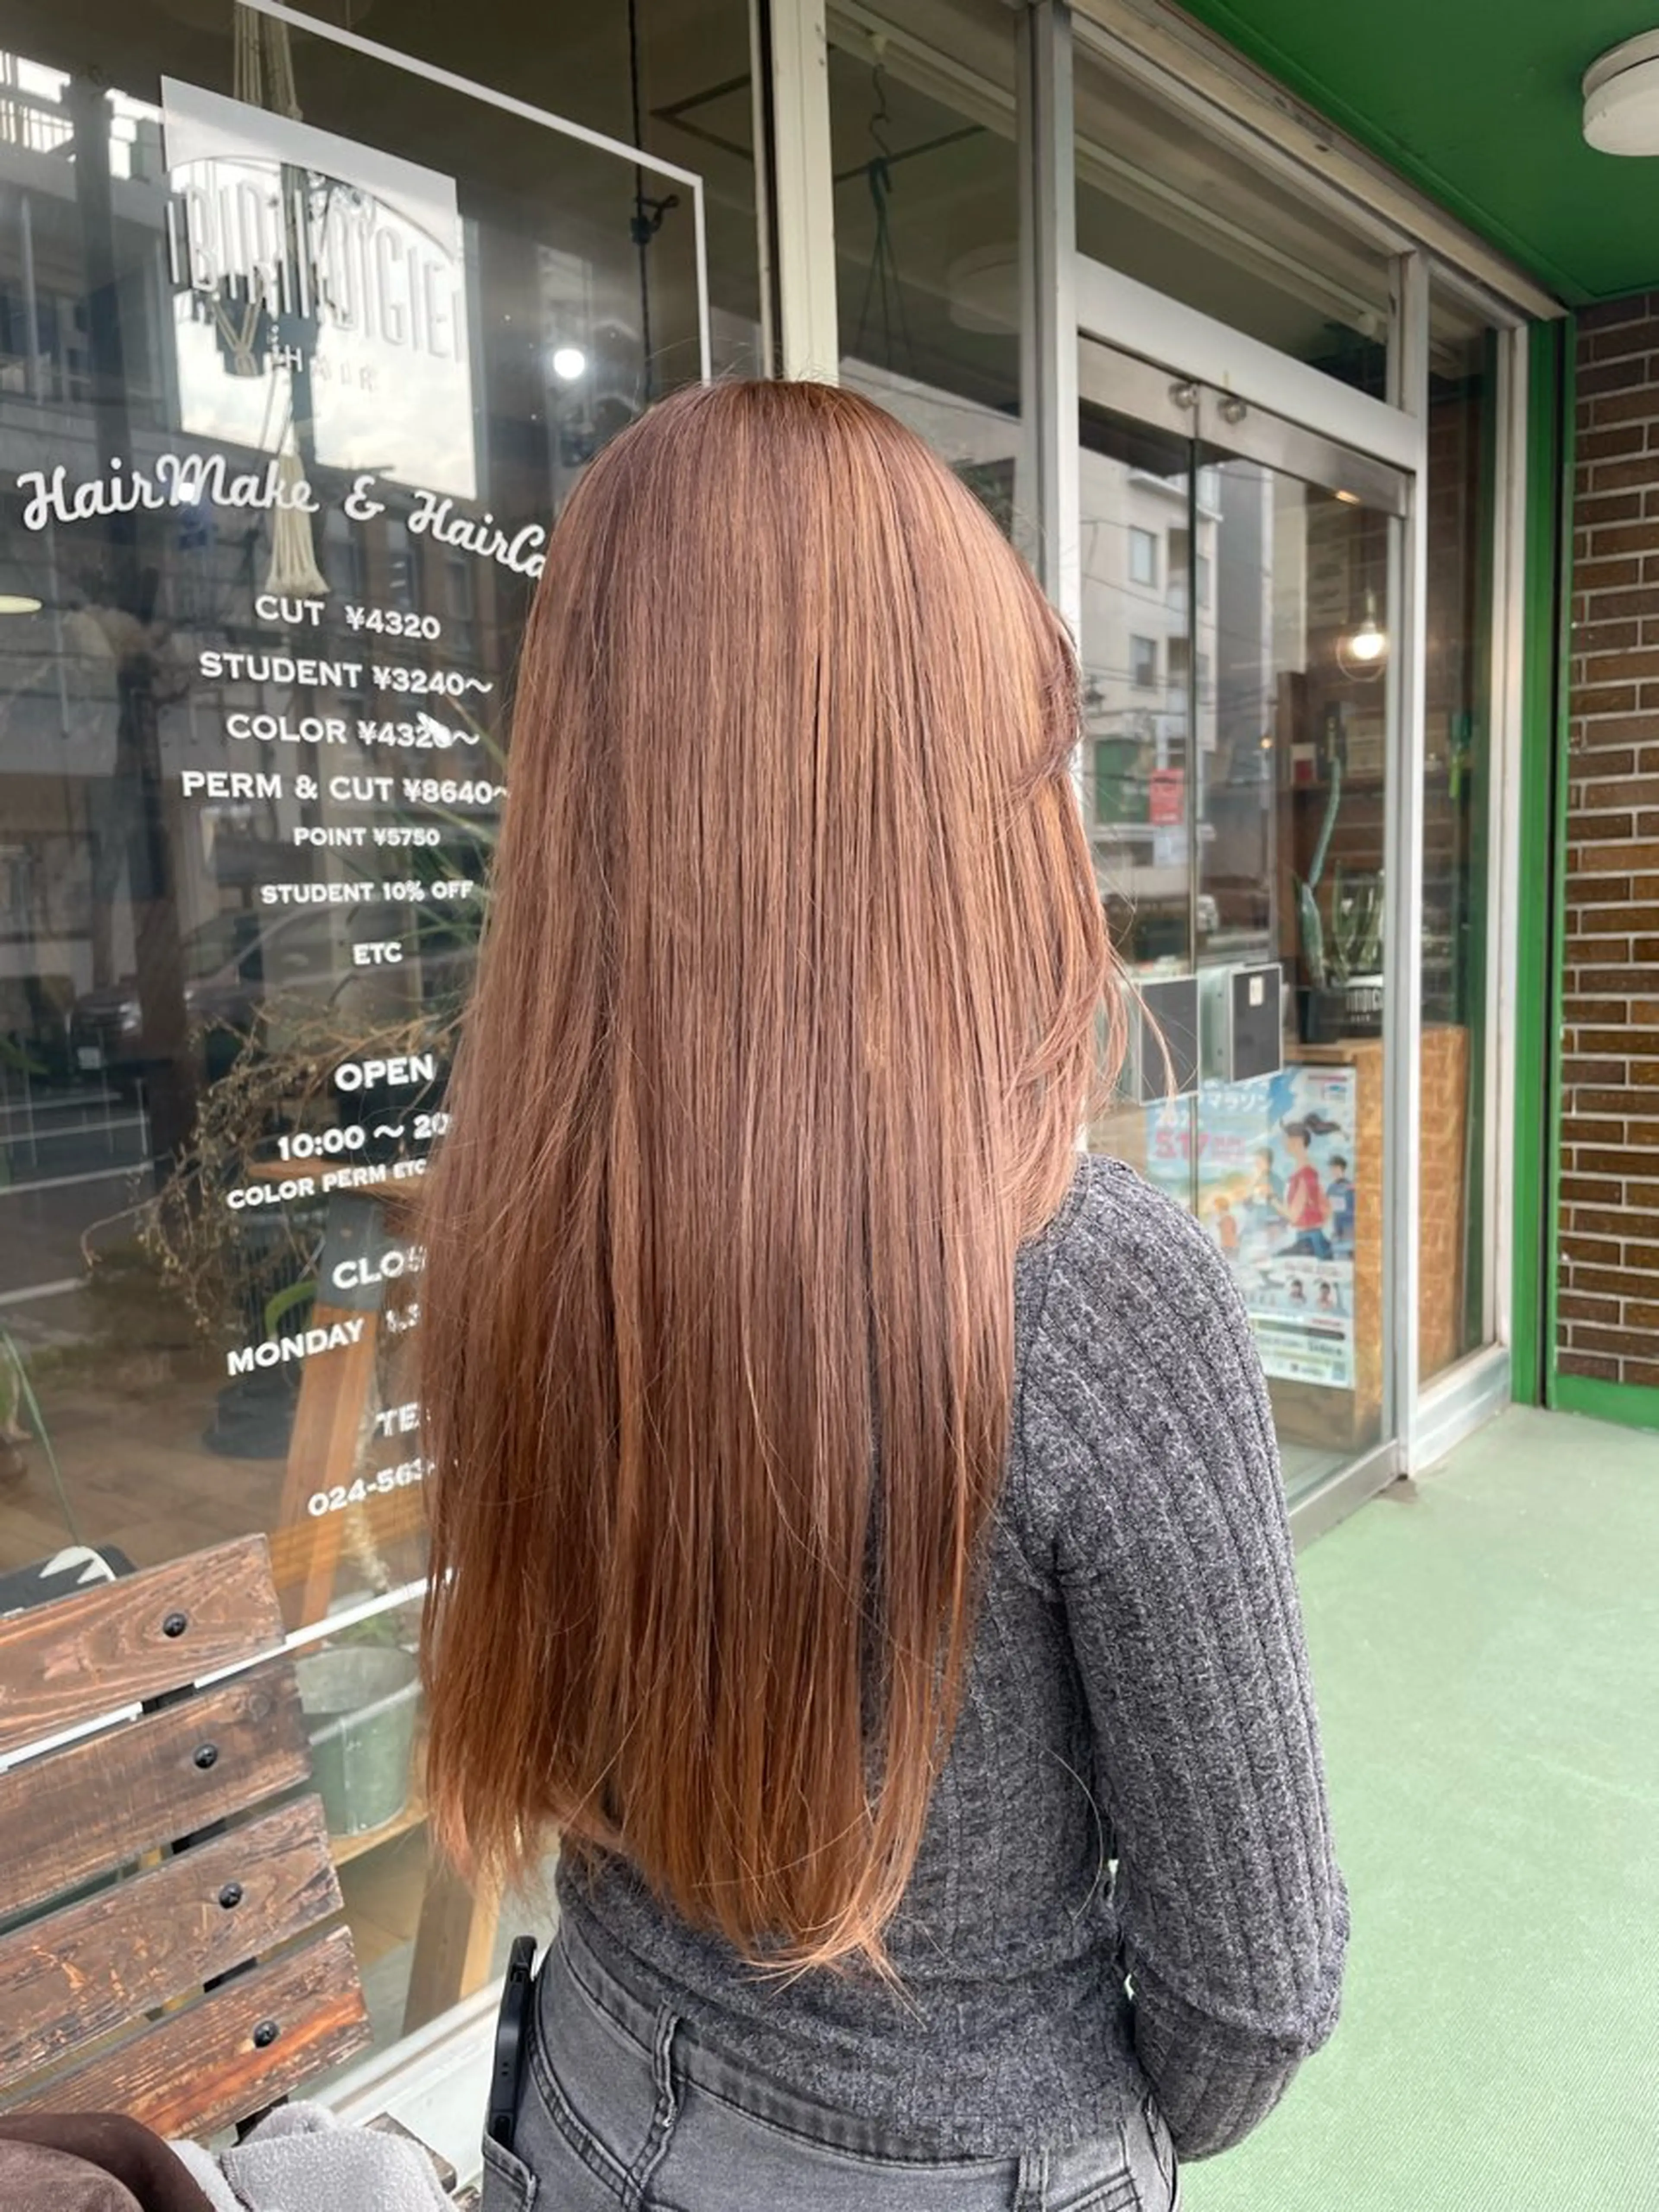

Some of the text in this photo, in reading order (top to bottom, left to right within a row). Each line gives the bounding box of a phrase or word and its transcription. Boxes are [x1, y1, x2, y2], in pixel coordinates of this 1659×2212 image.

[345, 475, 385, 520] &
[255, 594, 441, 640] CUT ¥4320
[199, 651, 362, 689] STUDENT
[226, 714, 347, 744] COLOR
[181, 770, 282, 799] PERM
[295, 775, 318, 800] &
[329, 776, 394, 802] CUT
[293, 827, 441, 847] POINT ¥5750
[261, 879, 474, 904] STUDENT 10% OFF
[352, 942, 403, 966] ETC
[334, 1053, 433, 1092] OPEN
[278, 1125, 365, 1162] 10:00
[226, 1158, 427, 1209] COLOR PERM ETC
[227, 1318, 365, 1376] MONDAY
